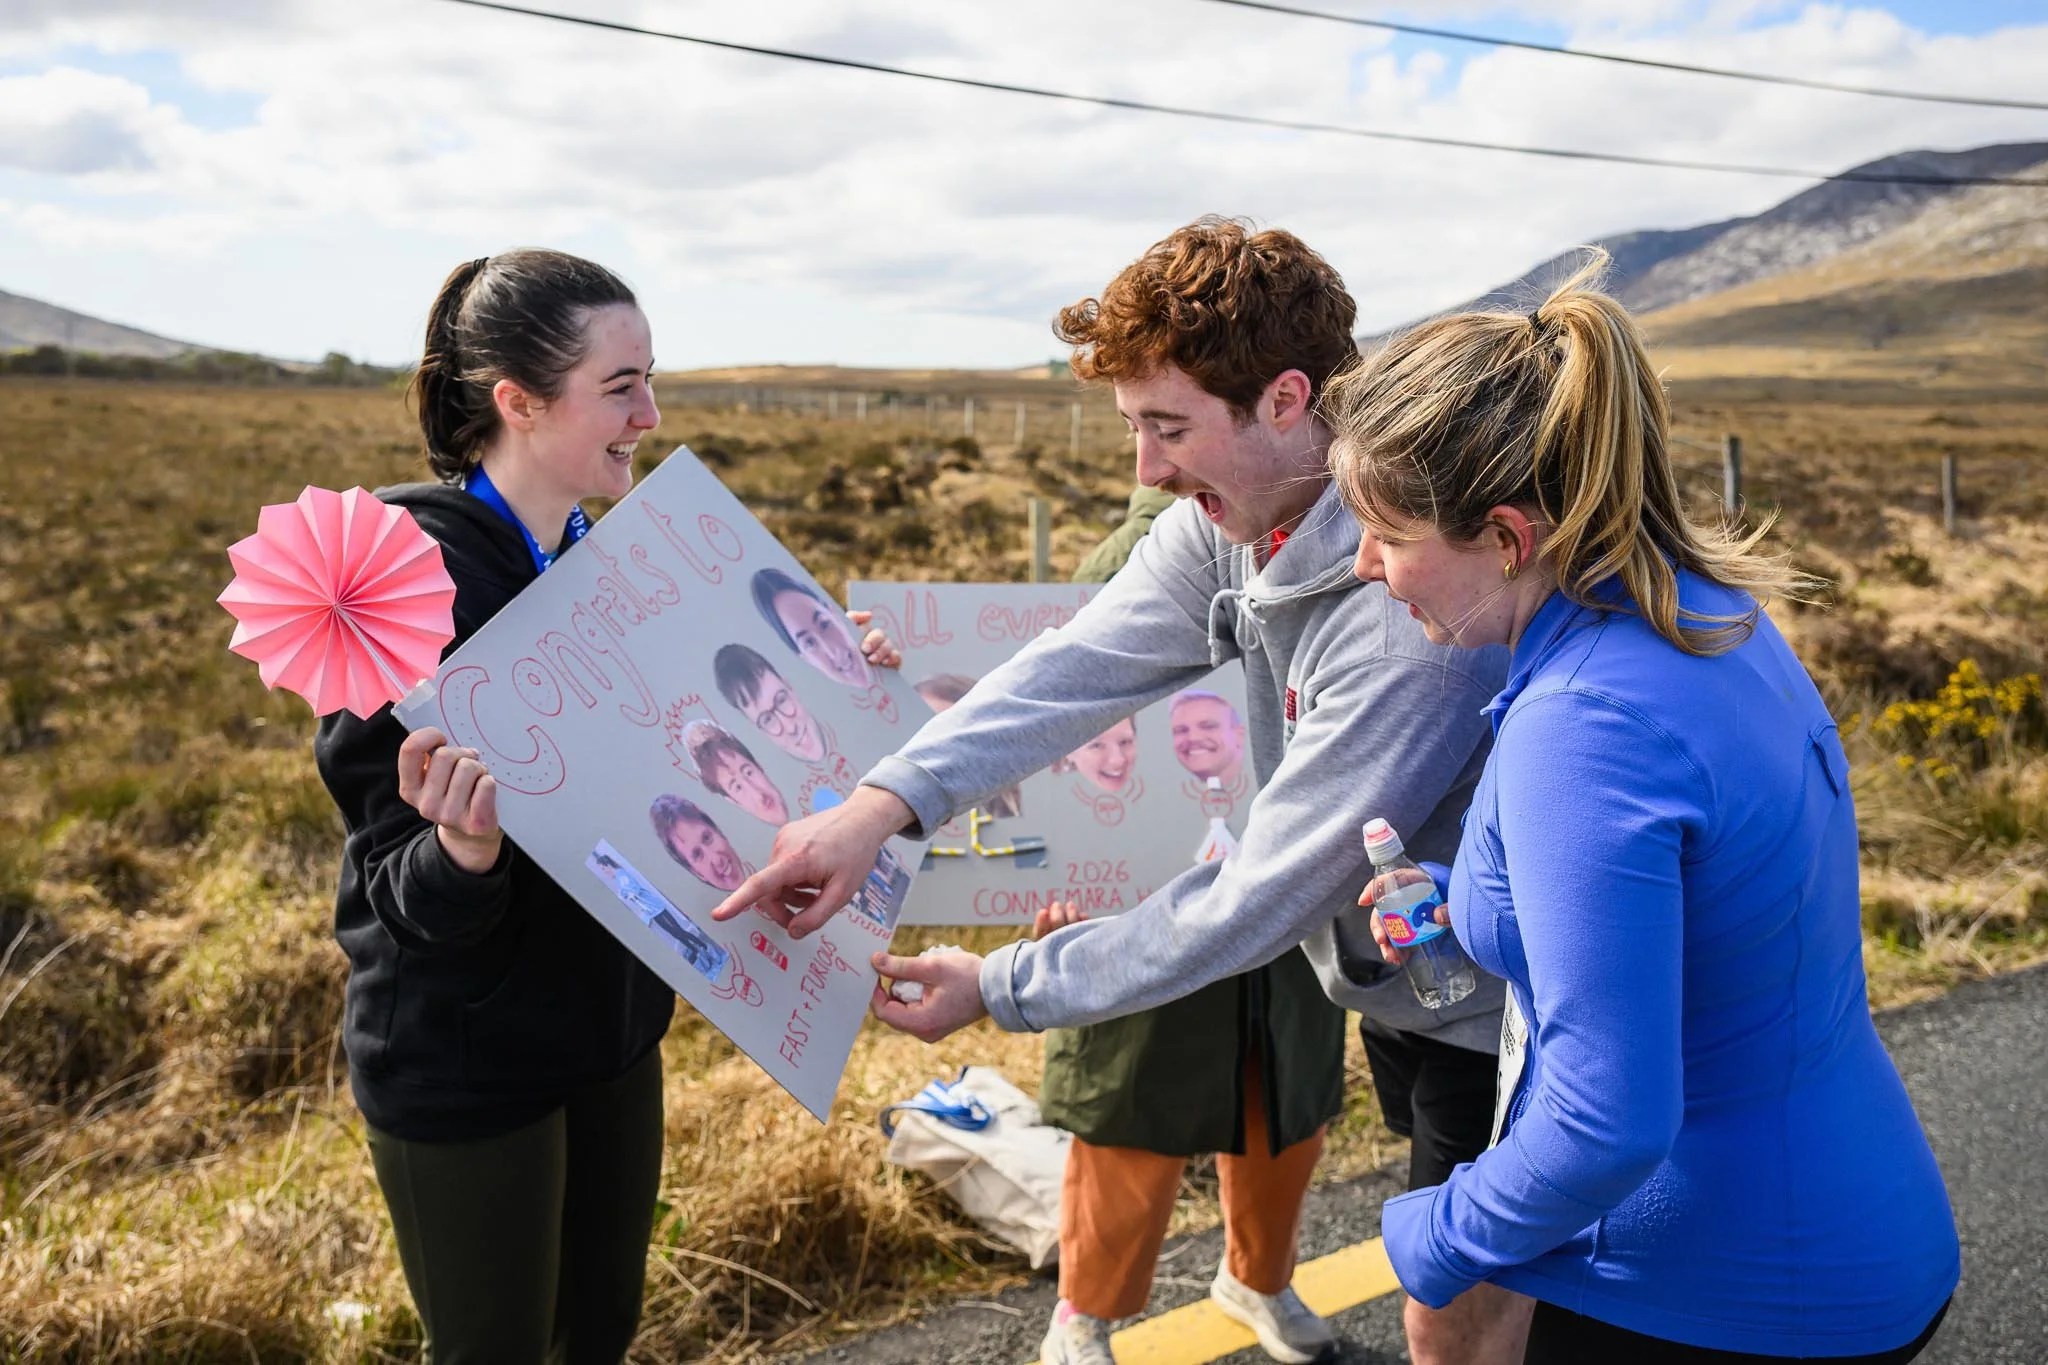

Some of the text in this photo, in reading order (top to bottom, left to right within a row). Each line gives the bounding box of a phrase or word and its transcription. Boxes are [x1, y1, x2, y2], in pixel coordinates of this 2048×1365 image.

[439, 500, 744, 795] Congrats to
[1066, 860, 1131, 885] 2026
[779, 1008, 812, 1069] FAST
[800, 934, 838, 1003] FURIOUS
